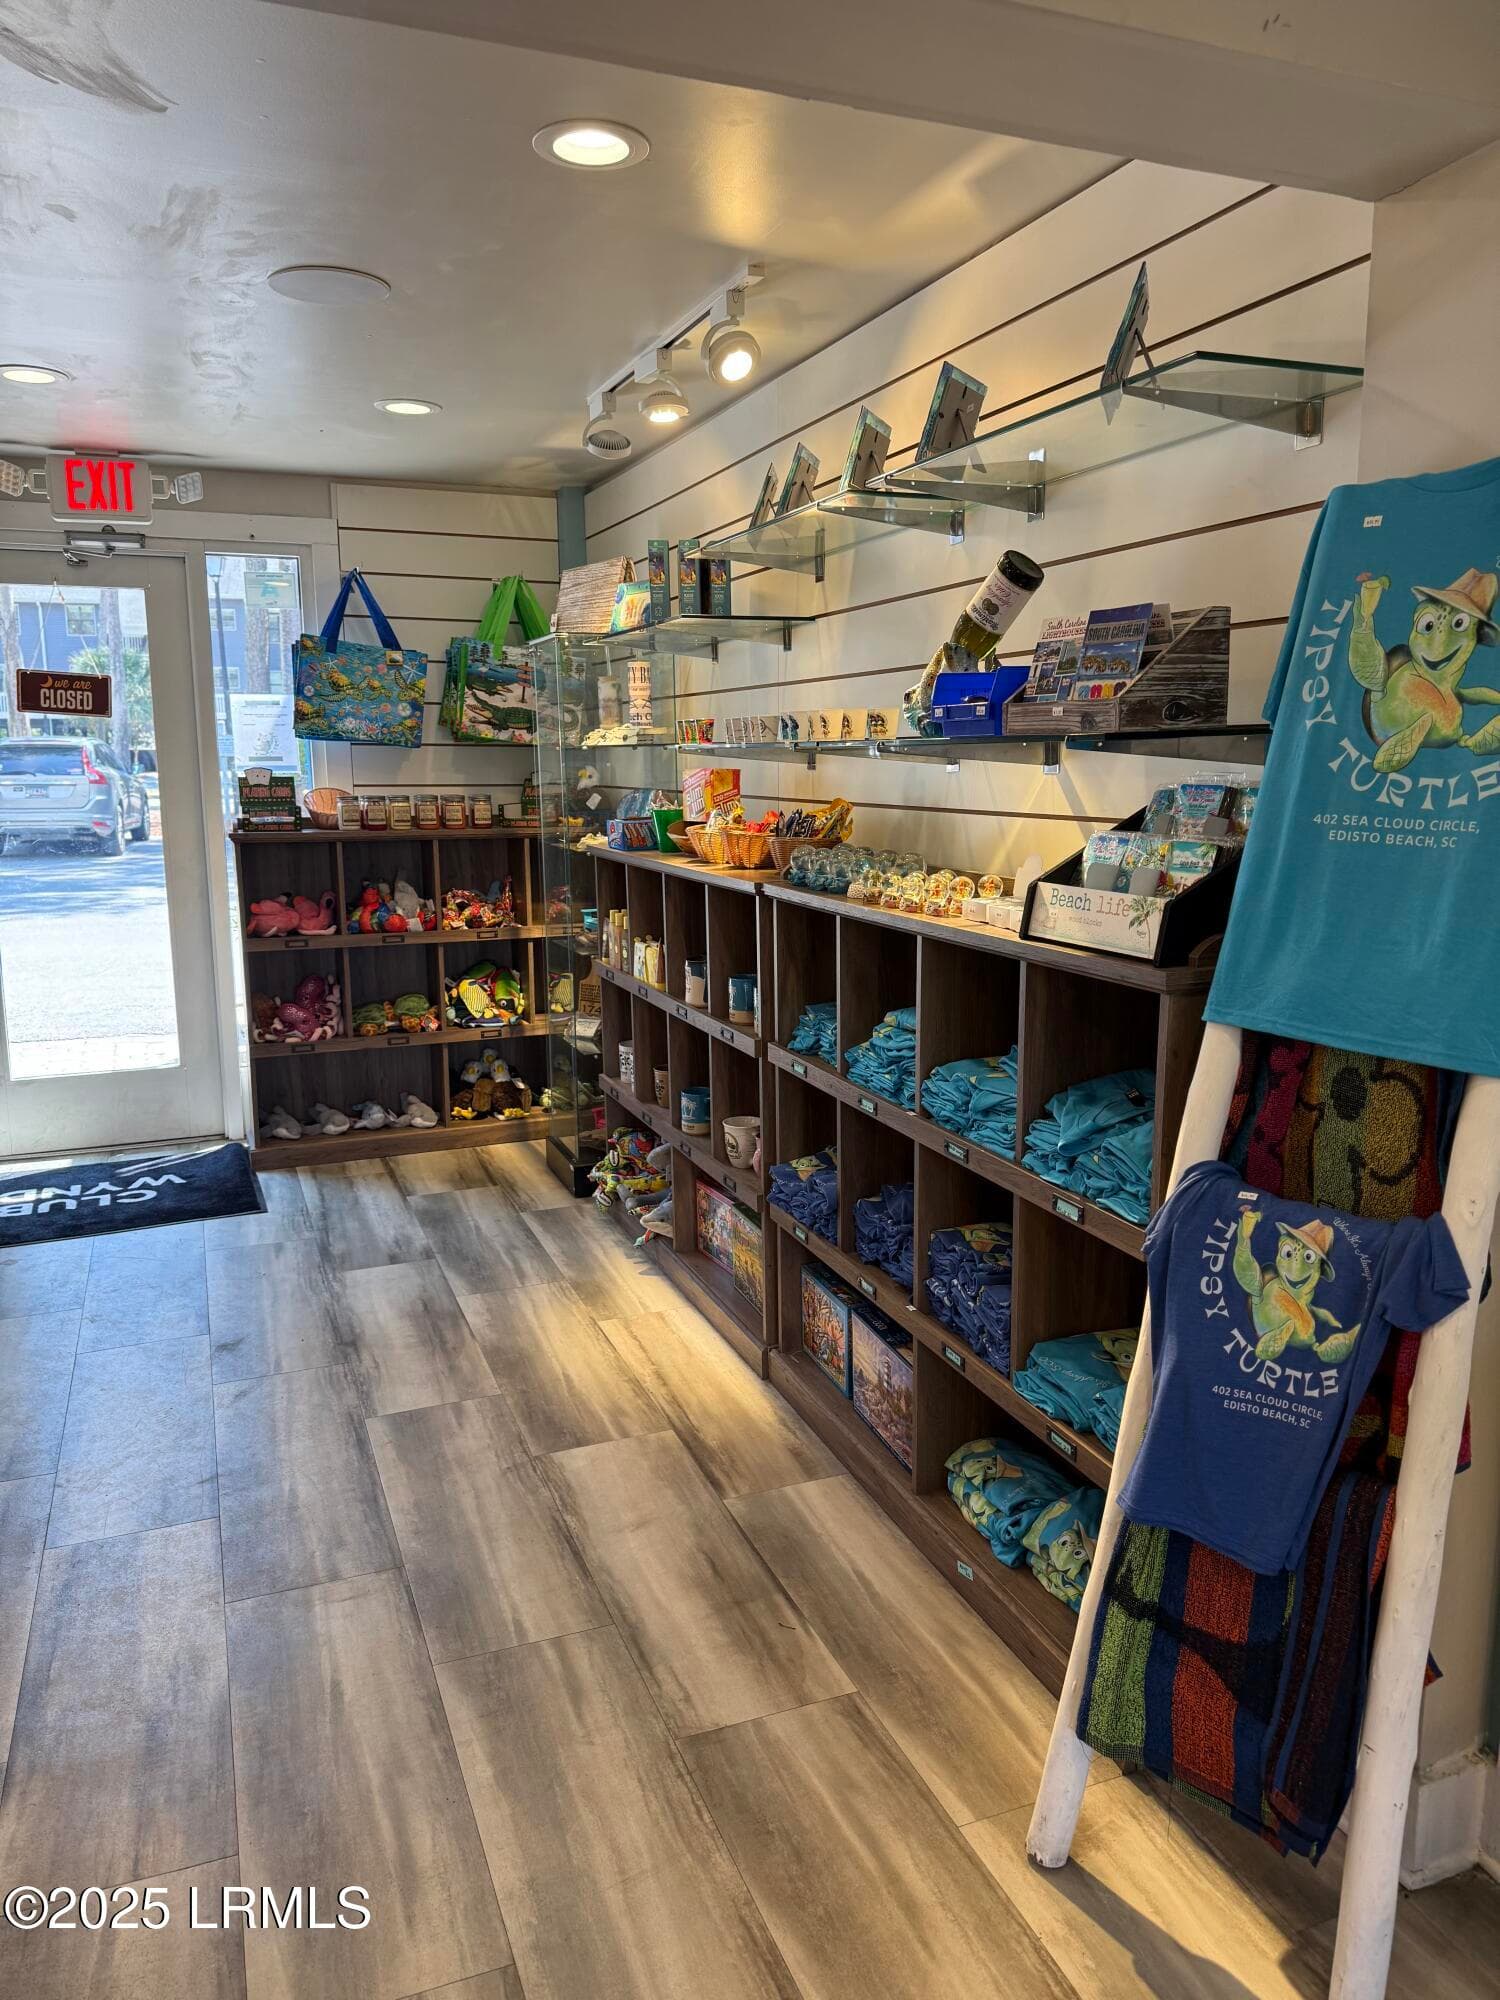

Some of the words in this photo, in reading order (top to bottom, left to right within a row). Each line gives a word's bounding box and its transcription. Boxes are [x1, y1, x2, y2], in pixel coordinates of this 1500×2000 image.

[65, 459, 135, 512] EXIT
[1088, 627, 1110, 641] SOUTH
[1111, 622, 1146, 639] CAROLINA
[1302, 598, 1352, 731] TIPSY
[54, 678, 70, 689] we
[73, 679, 92, 690] are
[40, 688, 93, 711] CLOSED
[1328, 736, 1500, 810] TURTLE
[1313, 813, 1338, 826] 402
[1343, 815, 1369, 828] SEA
[1374, 816, 1425, 831] CLOUD
[1430, 819, 1480, 834] CIRCLE,
[1329, 829, 1380, 844] EDISTO
[1386, 832, 1438, 849] BEACH,
[1441, 836, 1457, 848] SC
[1050, 887, 1092, 912] Beach
[1096, 895, 1131, 918] life
[0, 1189, 158, 1217] CLUB
[1200, 1217, 1238, 1320] TIPSY
[1223, 1327, 1339, 1398] TURTLE
[1212, 1384, 1231, 1397] 402
[1233, 1388, 1252, 1401] SEA
[1255, 1393, 1289, 1409] CLOUD
[1292, 1402, 1323, 1422] CIRCLE,
[1223, 1399, 1260, 1415] EDISTO
[1262, 1408, 1299, 1427] BEACH,
[1299, 1418, 1311, 1429] SC
